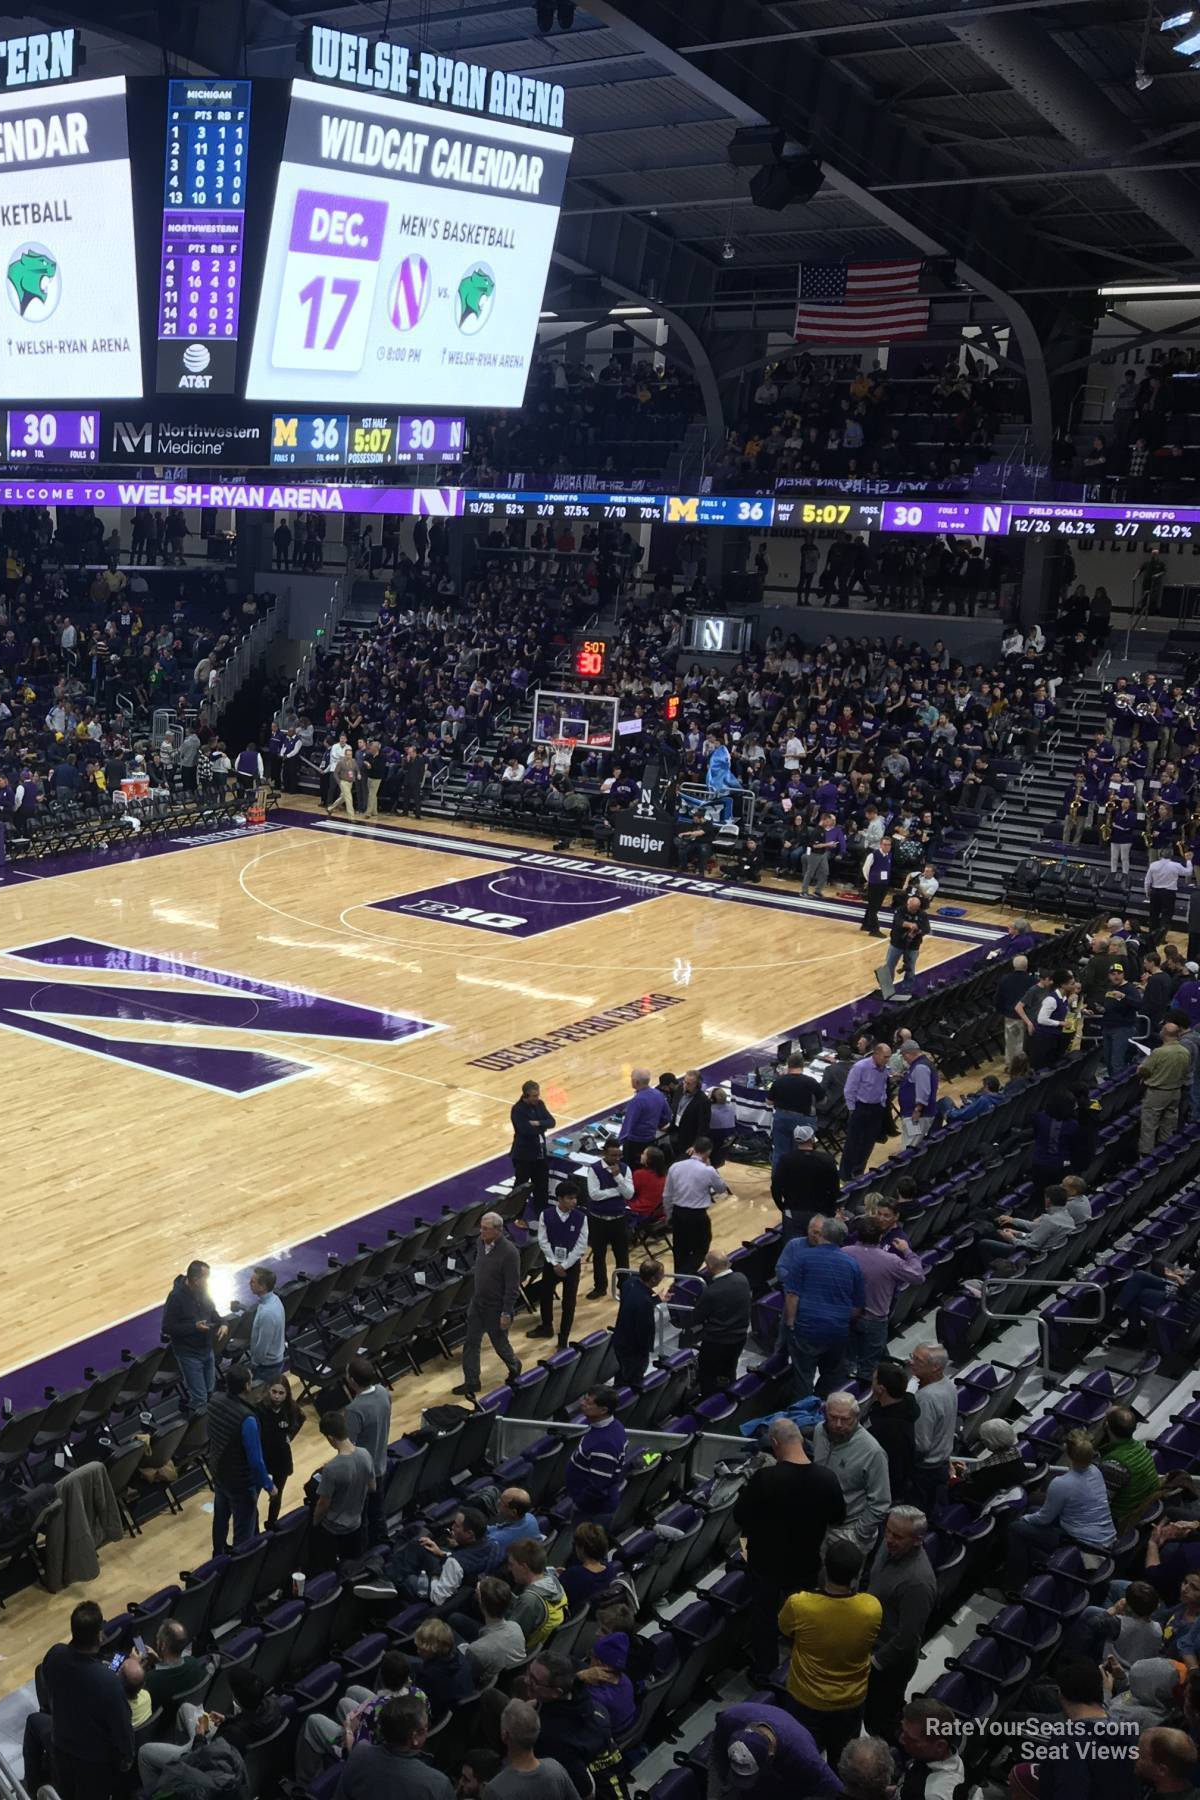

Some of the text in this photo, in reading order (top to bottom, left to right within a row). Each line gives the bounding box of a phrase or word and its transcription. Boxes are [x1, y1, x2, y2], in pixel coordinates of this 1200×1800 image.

[312, 26, 565, 128] WELSH-RYAN ARENA
[187, 91, 232, 99] MICHIGAN
[194, 111, 244, 120] PTS RB F
[171, 126, 243, 139] 1 3 1 1
[171, 142, 243, 156] 2 11 1 0
[321, 115, 543, 195] WILDCAT CALENDAR
[170, 159, 241, 172] 3 8 3 1
[169, 175, 241, 189] 4 0 3 0
[169, 192, 240, 205] 13 10 1 0
[168, 224, 239, 233] NORTHWESTERN
[310, 208, 368, 247] DEC.
[400, 214, 515, 249] MEN'S BASKETBALL
[188, 244, 237, 254] PTS RB F
[166, 259, 236, 272] 4 8 2 3
[166, 276, 236, 288] 5 16 4 0
[164, 291, 234, 304] 11 0 3 1
[163, 307, 234, 319] 14 4 0 2
[299, 276, 361, 350] 17
[163, 323, 233, 335] 21 0 2 0
[17, 338, 130, 355] WELSH-RYAN ARENA
[386, 348, 421, 363] 8:00 PM
[448, 352, 524, 369] WELSH-RYAN ARENA
[178, 375, 213, 389] AT&T
[23, 413, 95, 445] 30 N
[361, 418, 387, 429] 1ST HALF
[158, 423, 260, 439] Northwestern
[273, 417, 339, 449] M 36
[409, 419, 461, 449] 30 N
[157, 440, 223, 455] Medicine
[354, 429, 392, 453] 5:07
[348, 454, 383, 463] POSSESSION
[85, 488, 105, 500] TO
[118, 484, 264, 508] WELSH-RYAN
[267, 487, 344, 511] ARENA
[469, 502, 525, 514] 13/25 52%
[537, 504, 589, 516] 3/8 37.5%
[604, 506, 661, 519] 7/10 70%
[668, 498, 764, 522] M 36
[778, 503, 794, 512] HALF
[803, 504, 851, 524] 5:07
[860, 506, 880, 514] POSS.
[1029, 507, 1084, 517] FIELD GOALS
[779, 513, 790, 521] 1ST
[892, 506, 923, 527] 30
[982, 506, 1002, 532] N
[1133, 511, 1160, 520] POINT
[1162, 511, 1175, 520] FG
[1014, 520, 1095, 534] 12/26 46.2%
[1115, 523, 1192, 539] 3/7 42.9%
[703, 619, 724, 649] N
[584, 641, 605, 653] 5:07
[579, 652, 602, 674] 30
[642, 789, 652, 804] N
[619, 834, 664, 853] meijer
[519, 852, 715, 894] WILDCATS
[465, 993, 686, 1072] WELSH-RYAN ARENA
